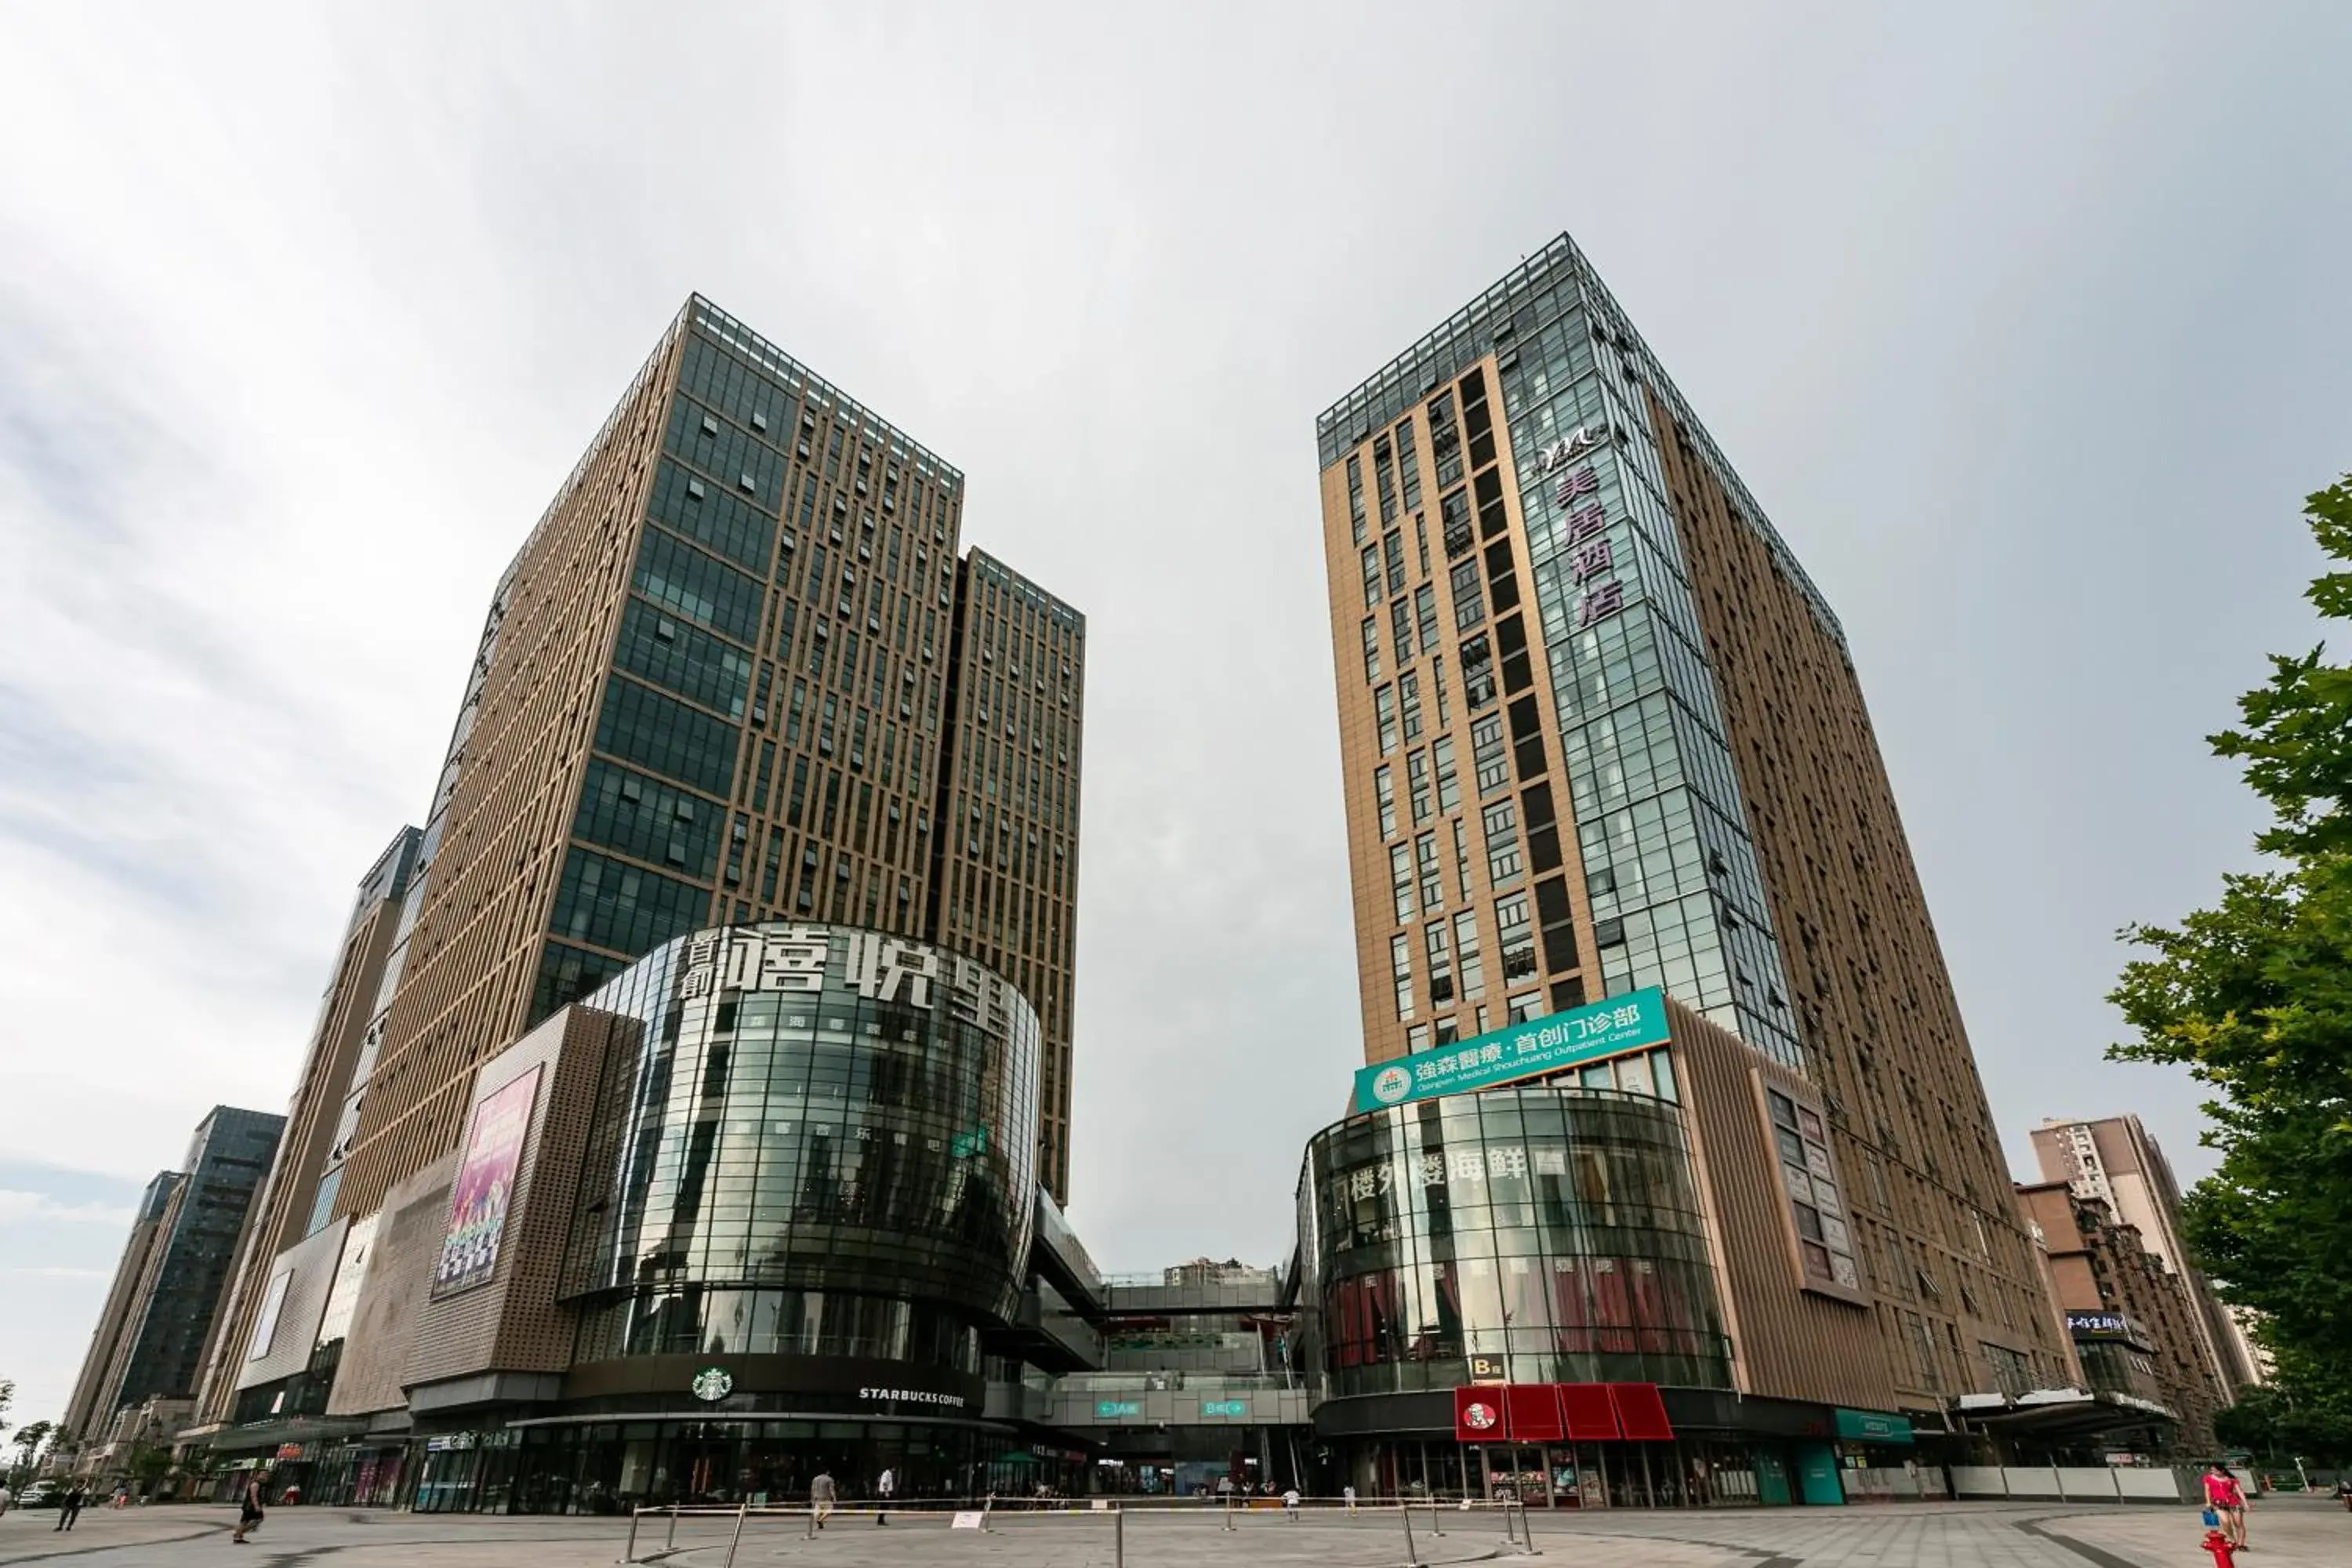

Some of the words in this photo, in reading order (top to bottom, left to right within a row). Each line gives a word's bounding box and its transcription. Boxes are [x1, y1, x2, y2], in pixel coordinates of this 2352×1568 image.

[1556, 466, 1624, 627] 美居酒店
[1555, 1036, 1606, 1057] Outpatient
[1608, 1028, 1642, 1043] Center
[859, 1387, 938, 1404] STARBUCKS
